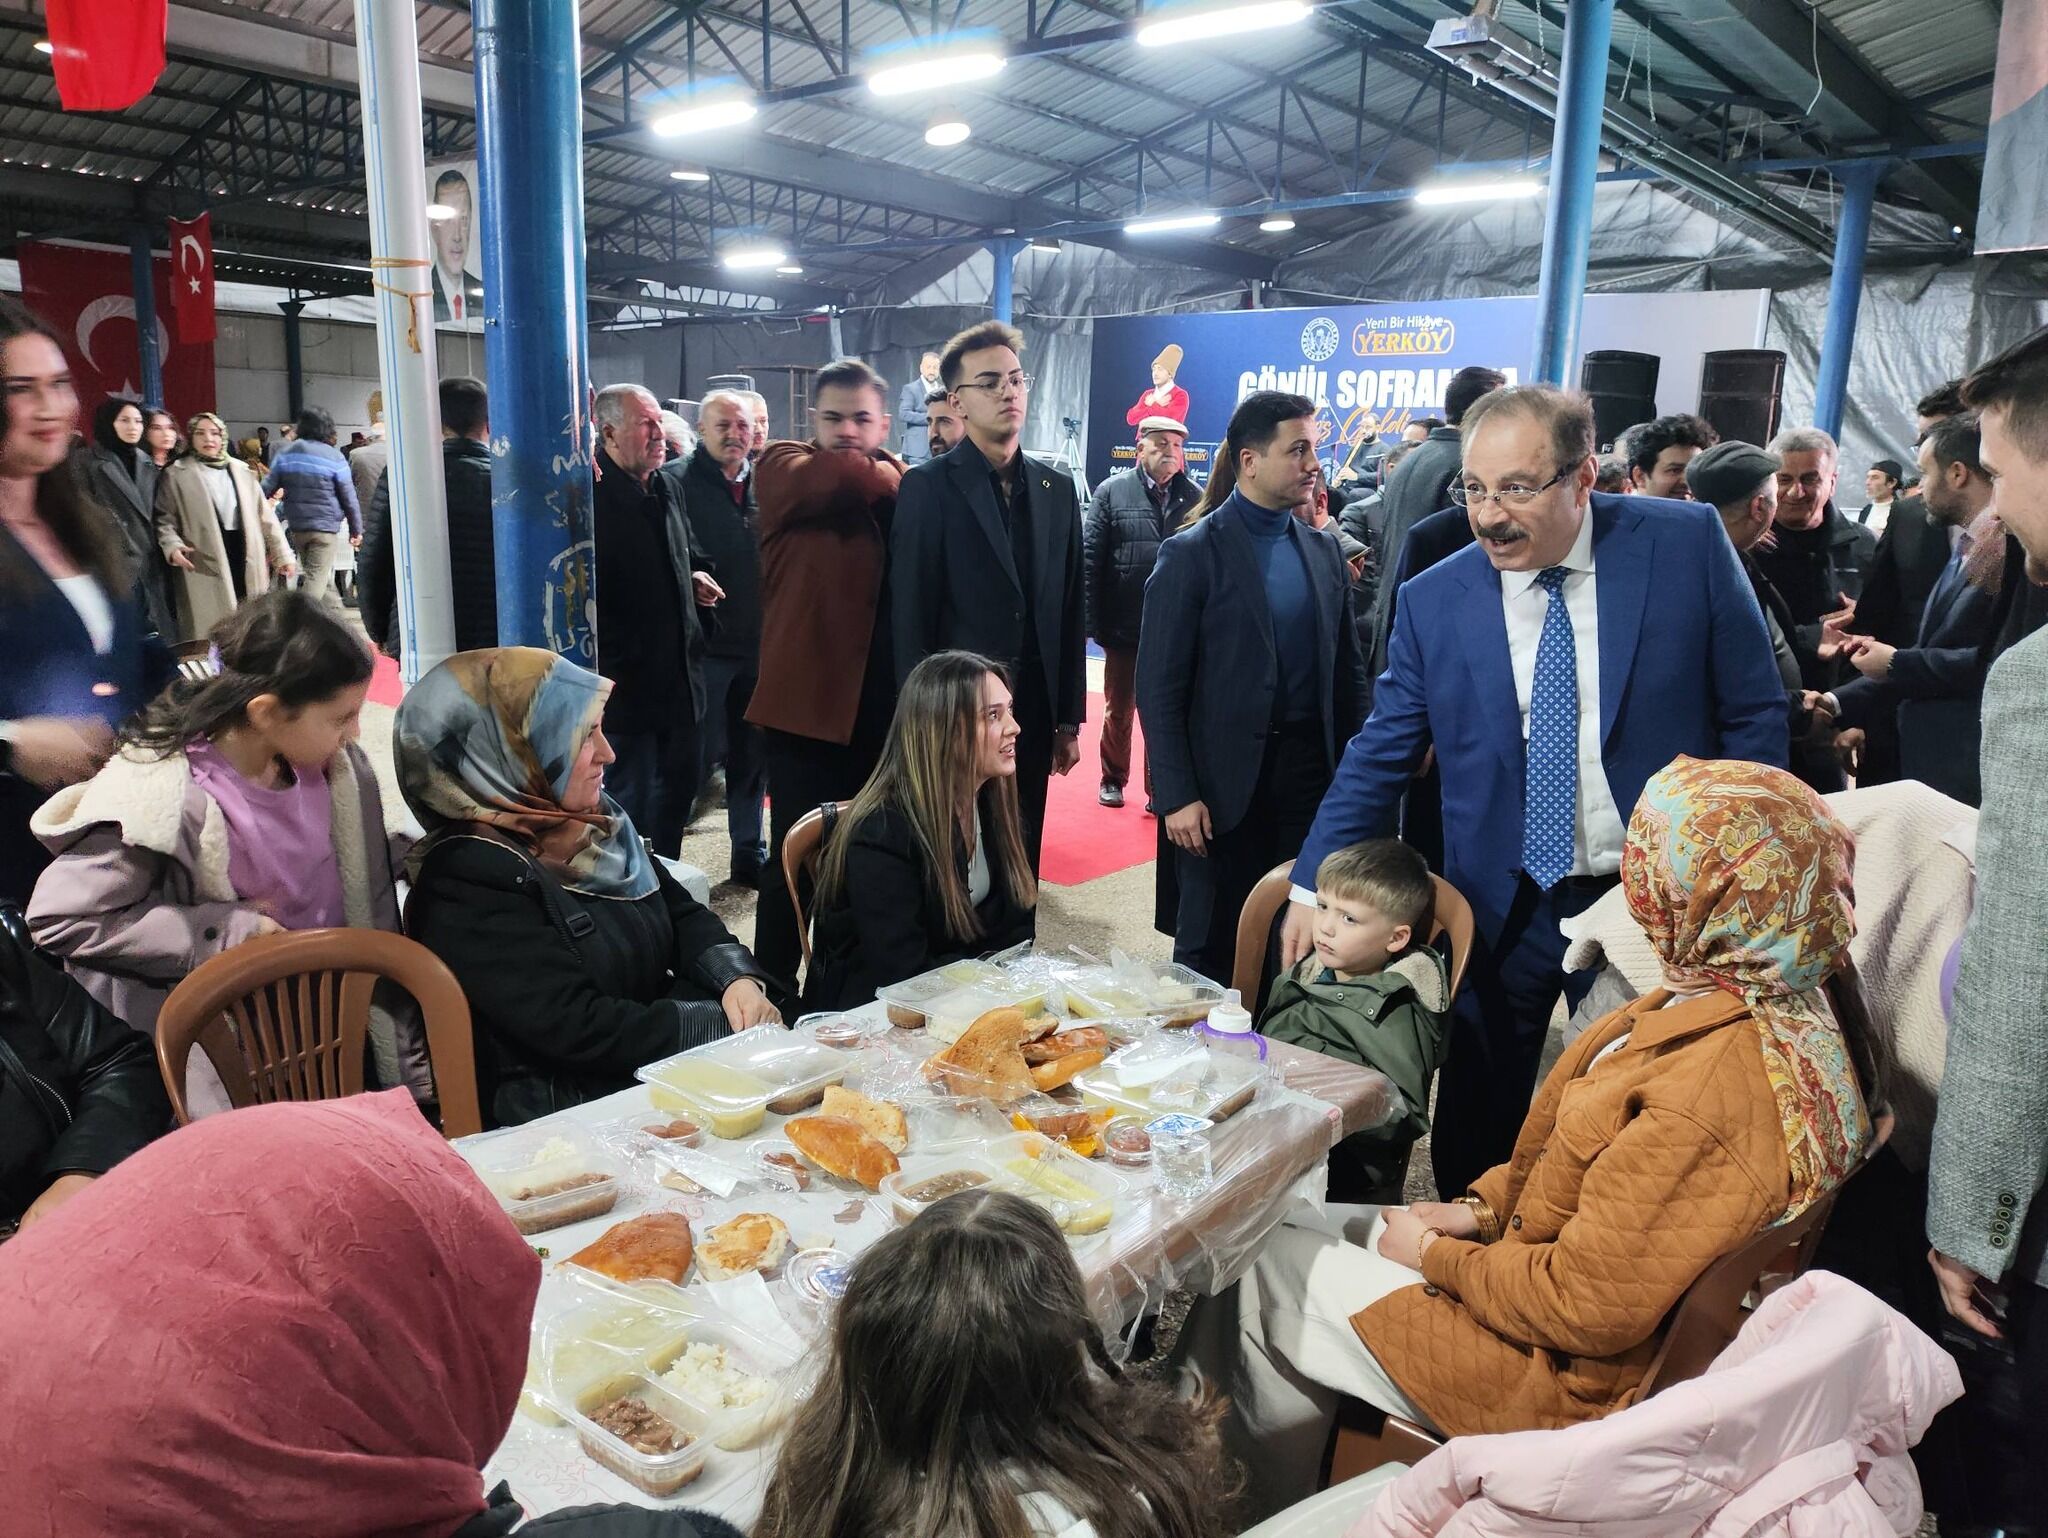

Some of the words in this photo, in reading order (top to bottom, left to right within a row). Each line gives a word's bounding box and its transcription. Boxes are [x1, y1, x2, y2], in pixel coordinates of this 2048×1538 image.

[1365, 317, 1388, 329] Yeni
[1389, 316, 1406, 329] Bir
[1358, 326, 1450, 353] YERKÖY
[1238, 365, 1328, 408] GÖNÜL
